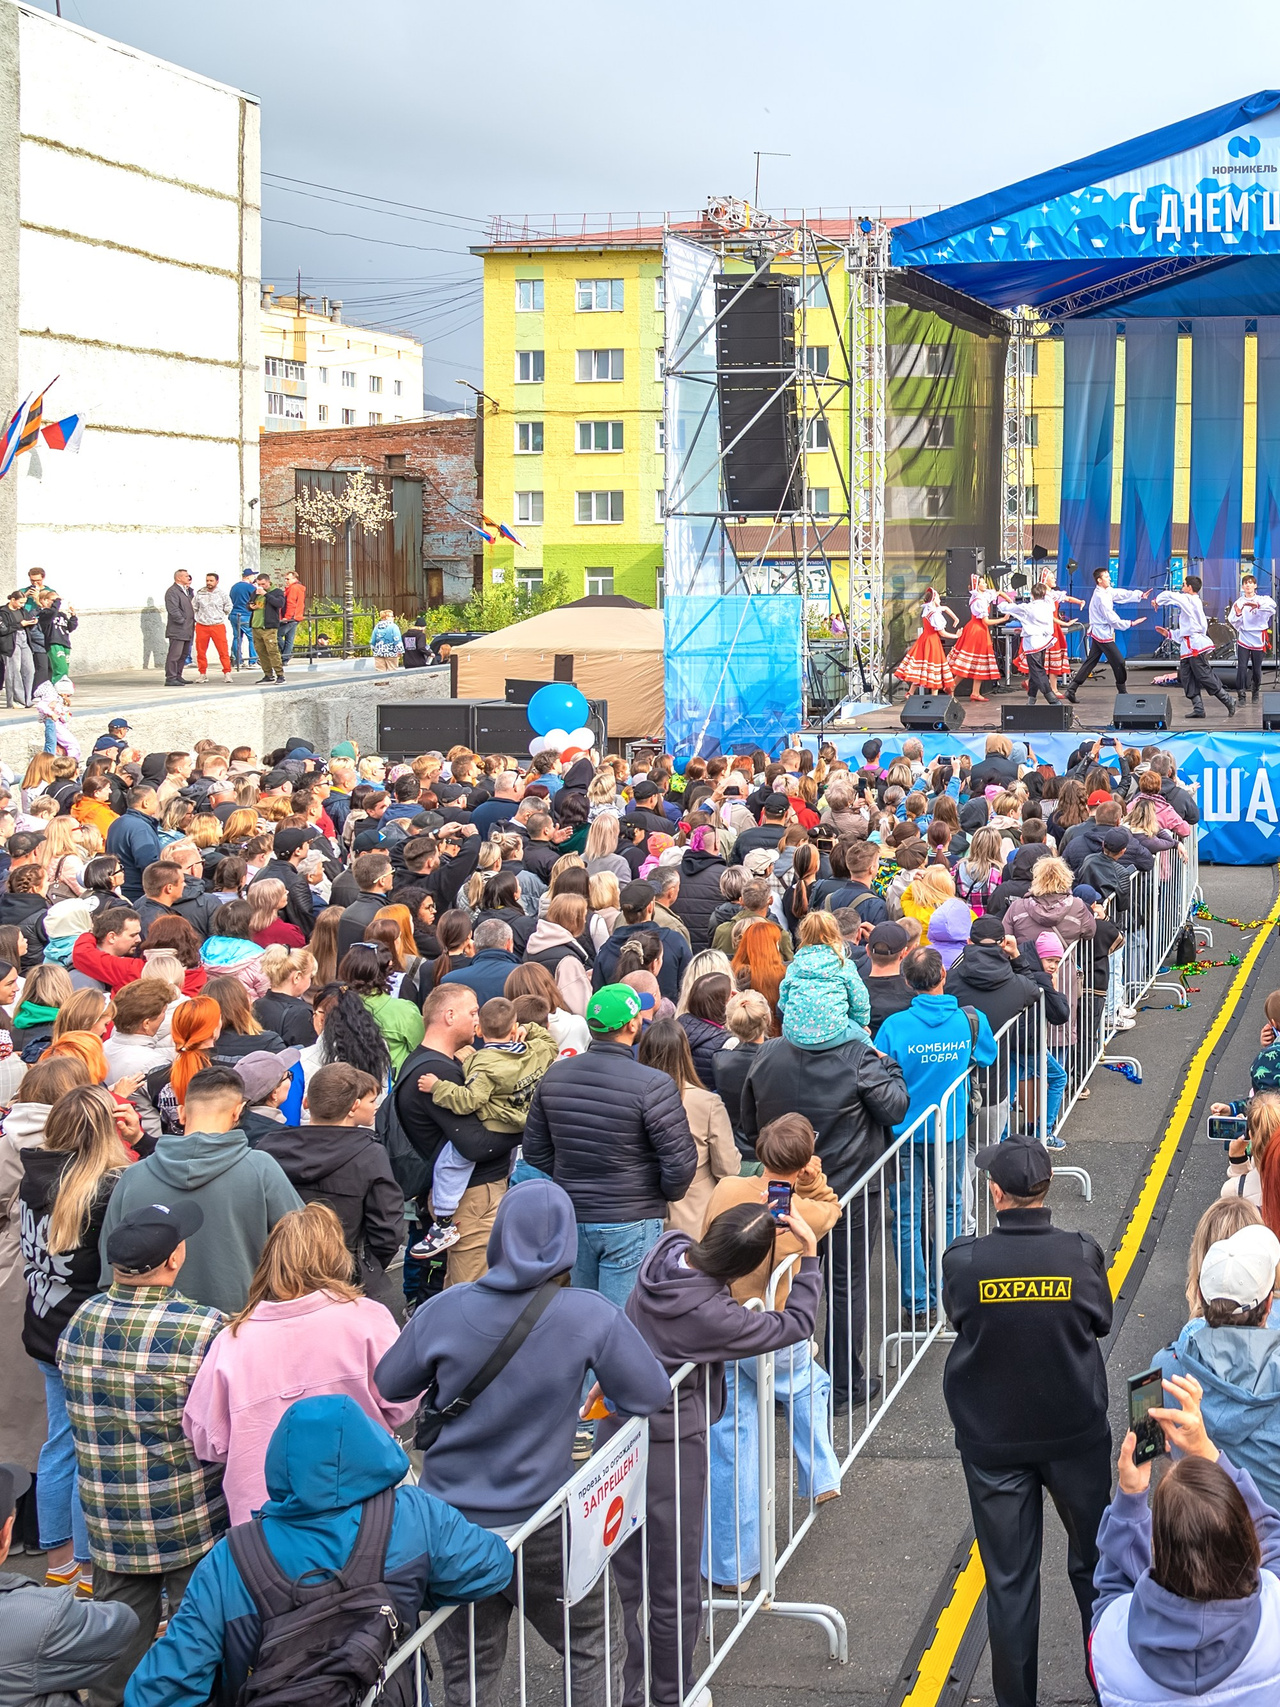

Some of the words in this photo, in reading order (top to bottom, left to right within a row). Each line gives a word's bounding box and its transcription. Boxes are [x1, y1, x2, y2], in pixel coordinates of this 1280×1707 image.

[1212, 164, 1278, 175] НОРНИКЕЛЬ
[1129, 194, 1146, 235] С
[1156, 191, 1249, 242] ДНЕМ
[908, 1039, 972, 1054] КОМБИНАТ
[921, 1052, 959, 1064] ДОБРА
[983, 1281, 1067, 1299] ОХРАНА
[578, 1474, 602, 1500] проезд
[602, 1465, 610, 1477] за
